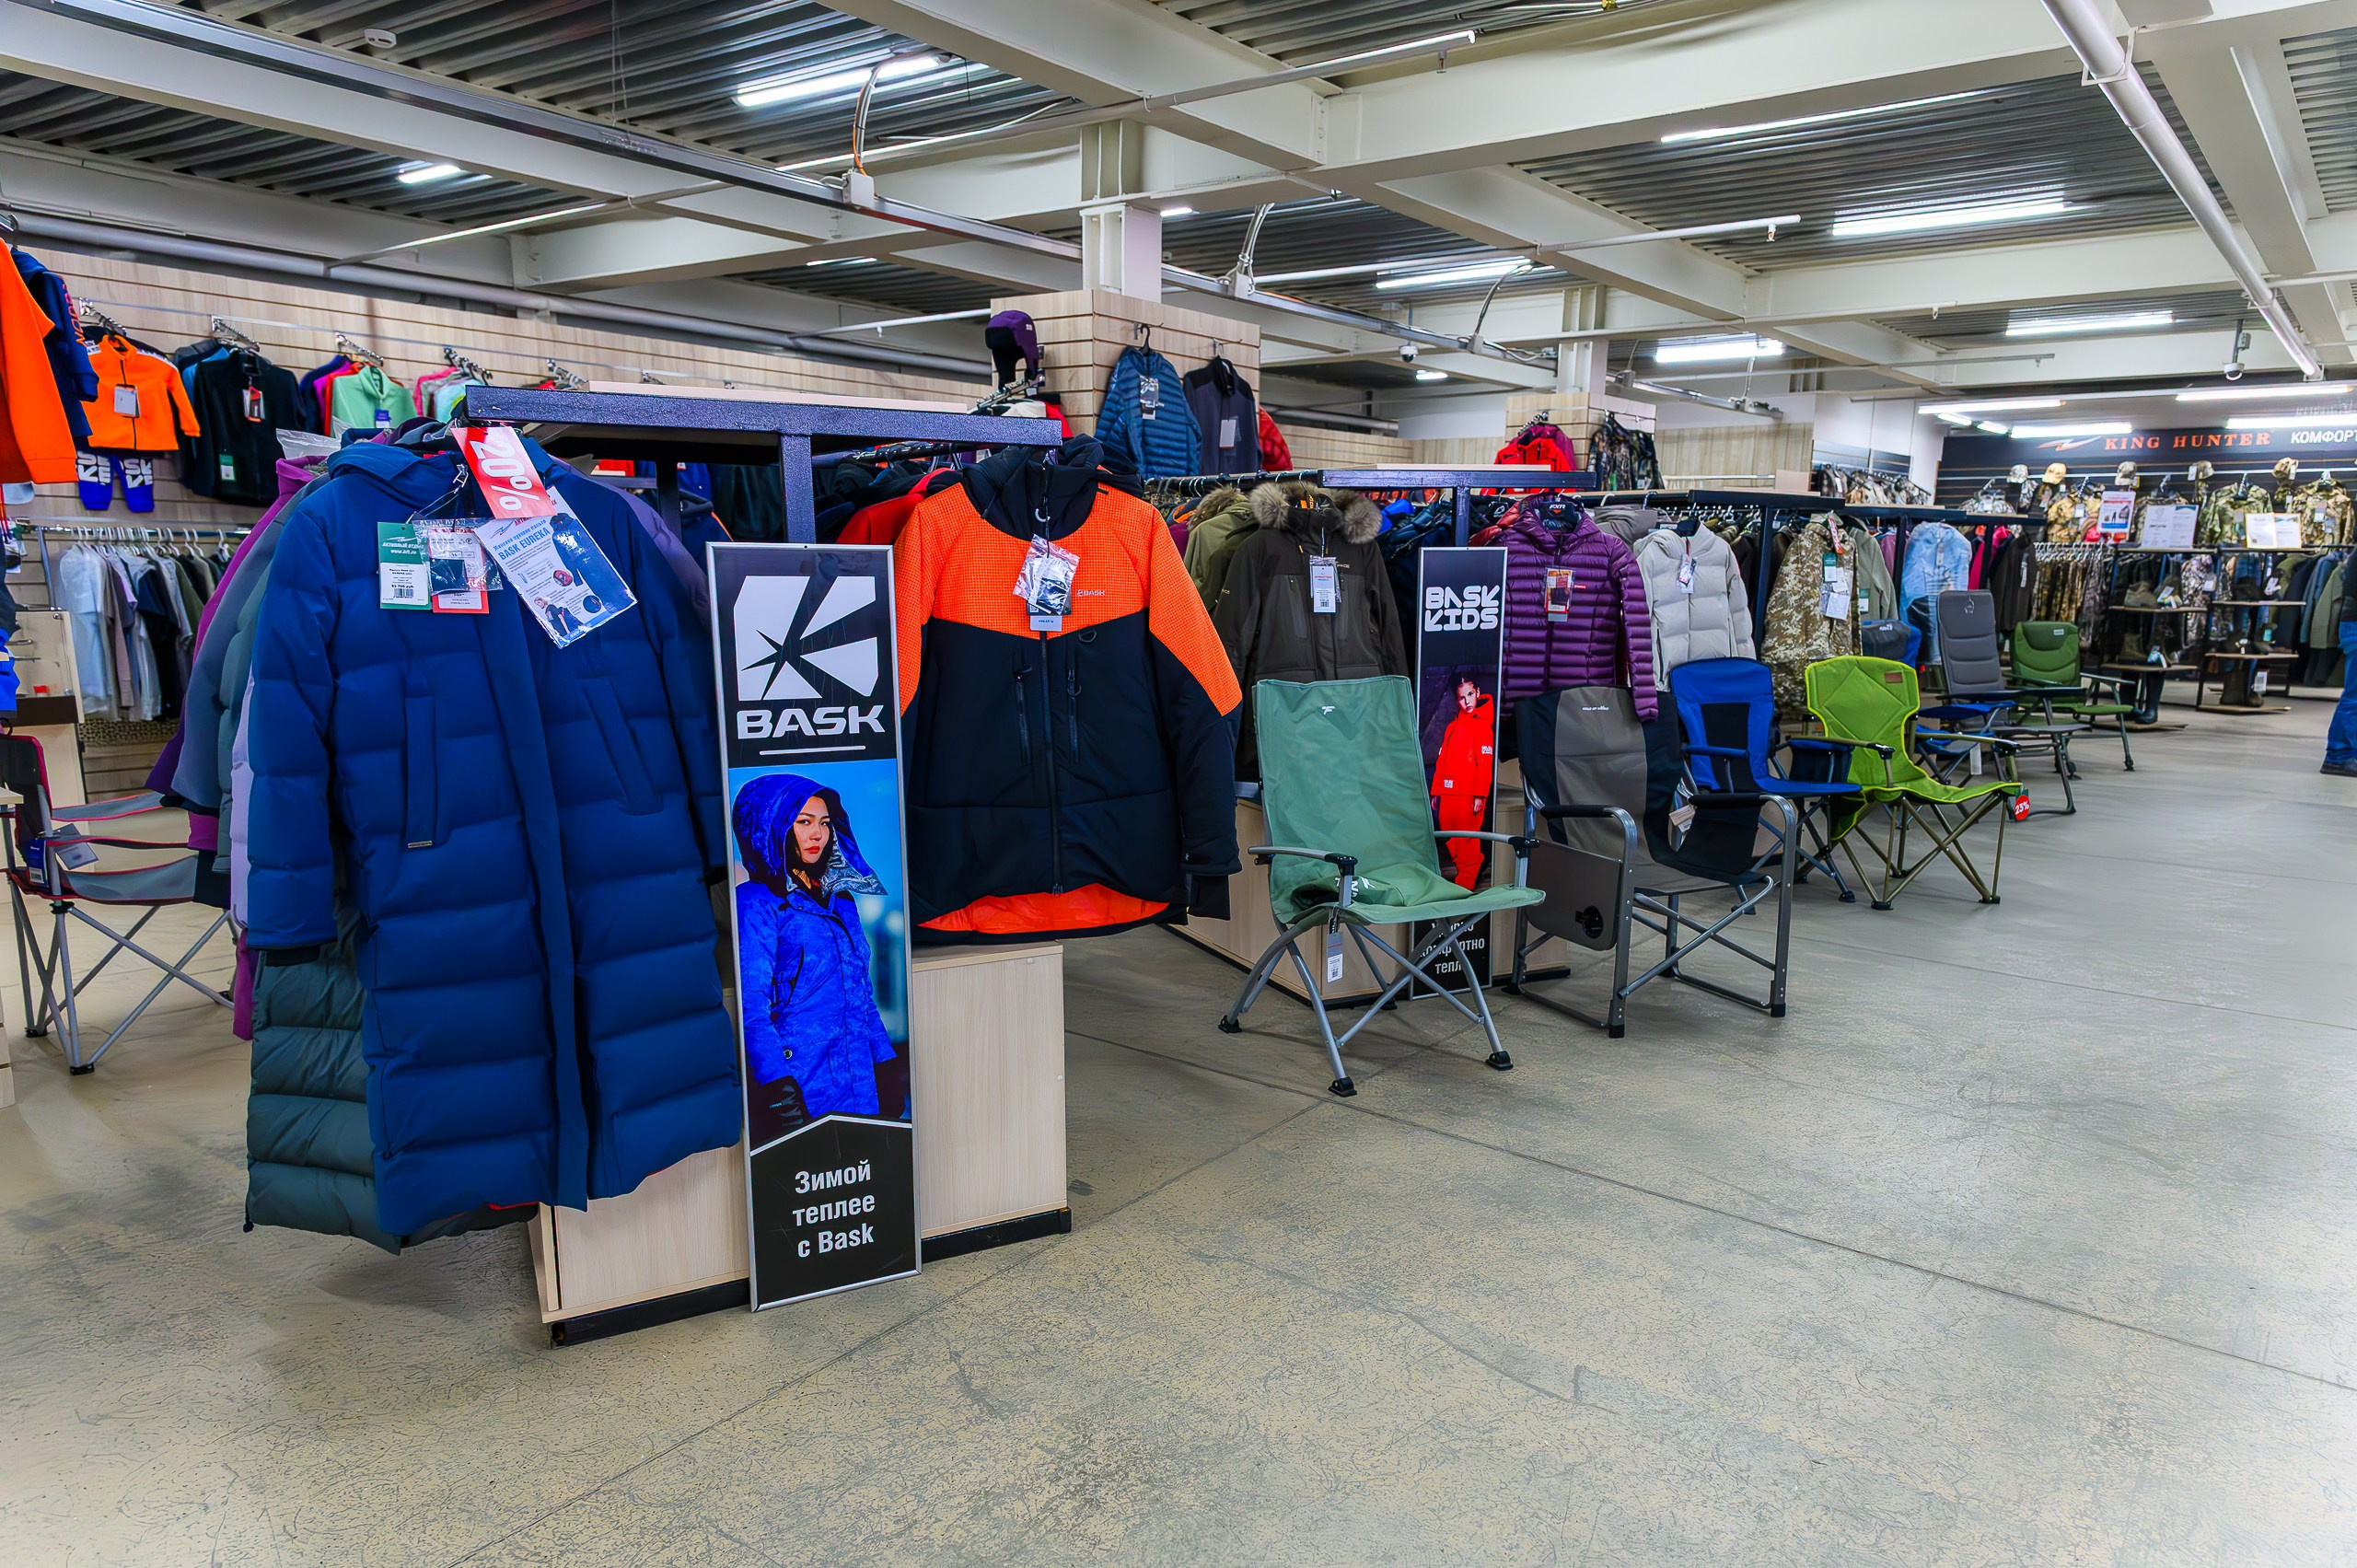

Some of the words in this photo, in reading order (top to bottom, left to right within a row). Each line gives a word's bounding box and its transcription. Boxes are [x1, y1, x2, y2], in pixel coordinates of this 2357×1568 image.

[2105, 436, 2161, 450] KING
[2172, 432, 2270, 448] HUNTER
[469, 440, 540, 511] 20%
[498, 543, 521, 561] BASK
[519, 527, 551, 549] EUREKA
[1425, 585, 1500, 609] BASK
[1424, 608, 1499, 632] KIDS
[737, 704, 886, 740] BASK
[795, 1158, 872, 1195] Зимой
[792, 1194, 876, 1227] теплее
[797, 1239, 811, 1259] с
[818, 1222, 875, 1254] Bask
